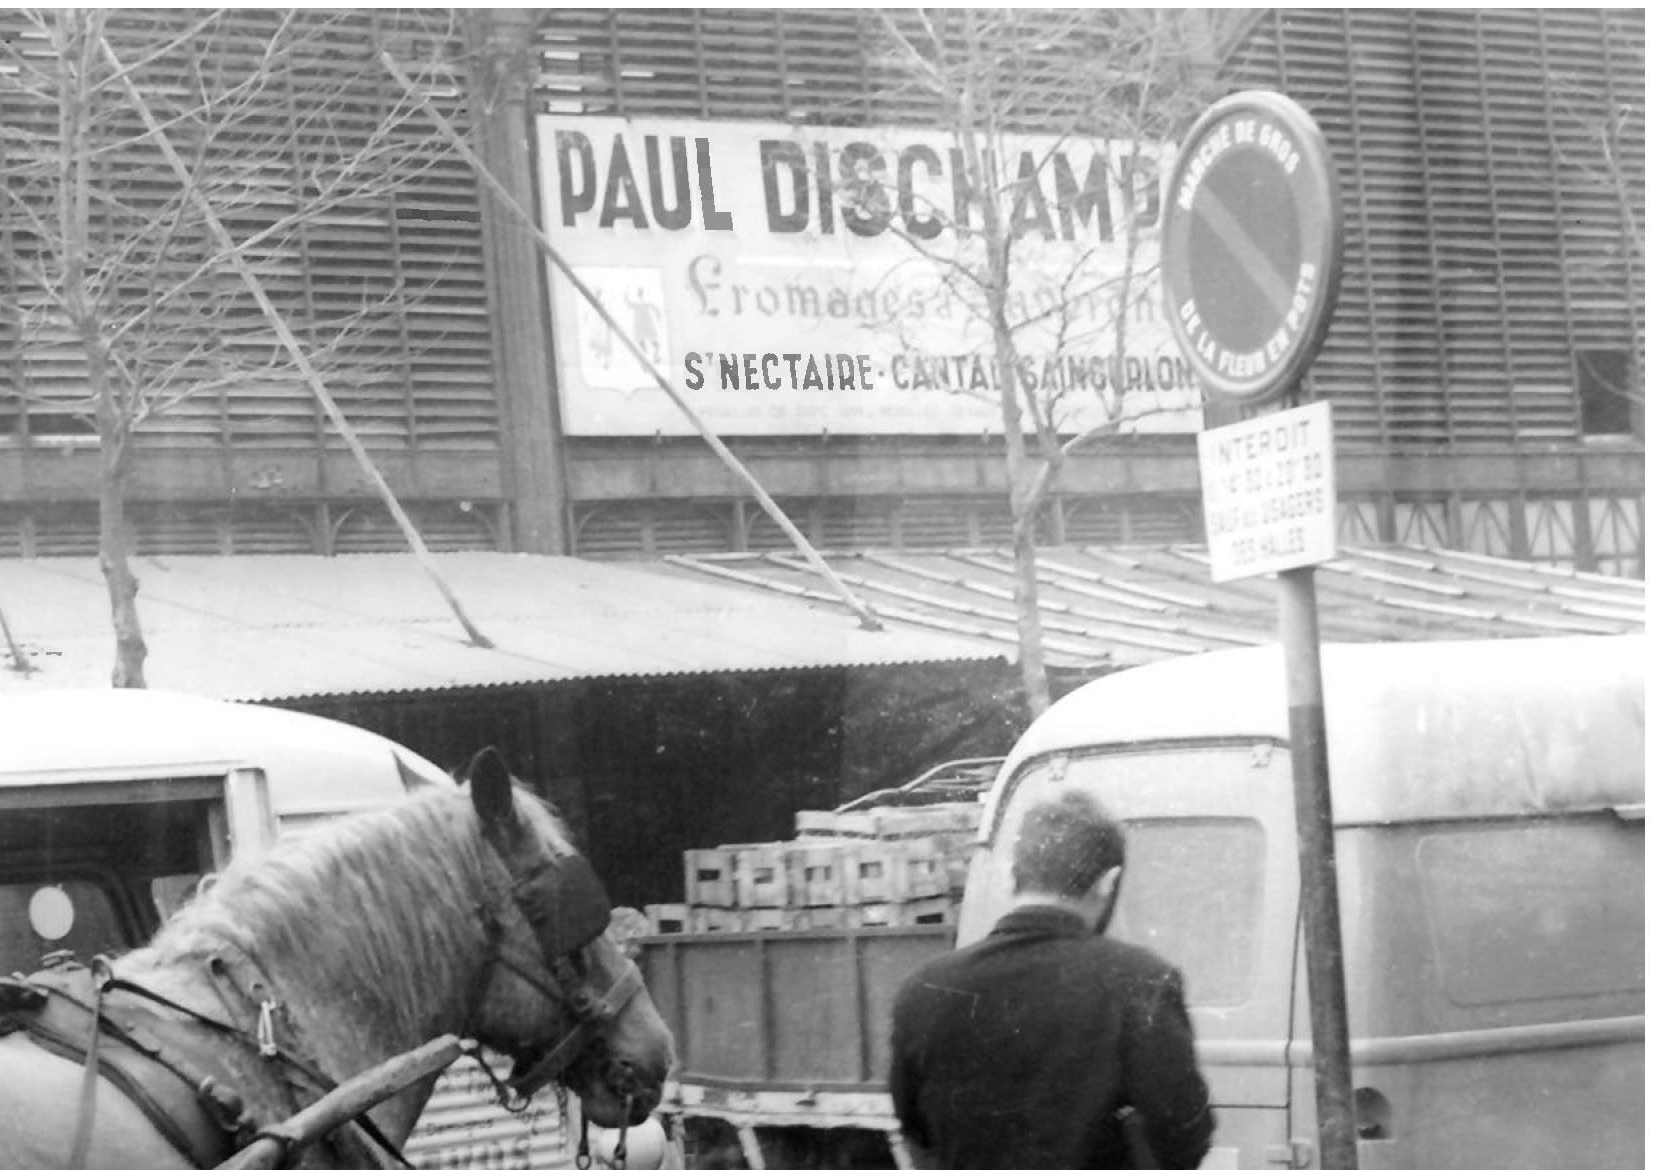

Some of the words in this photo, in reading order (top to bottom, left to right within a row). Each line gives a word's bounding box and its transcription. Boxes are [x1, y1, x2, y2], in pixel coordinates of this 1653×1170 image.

[1234, 119, 1257, 145] DE
[1258, 123, 1301, 174] GROS
[555, 129, 734, 231] PAUL
[1179, 298, 1202, 336] DE
[1197, 330, 1217, 364] LA
[1210, 418, 1312, 466] INTERDIT
